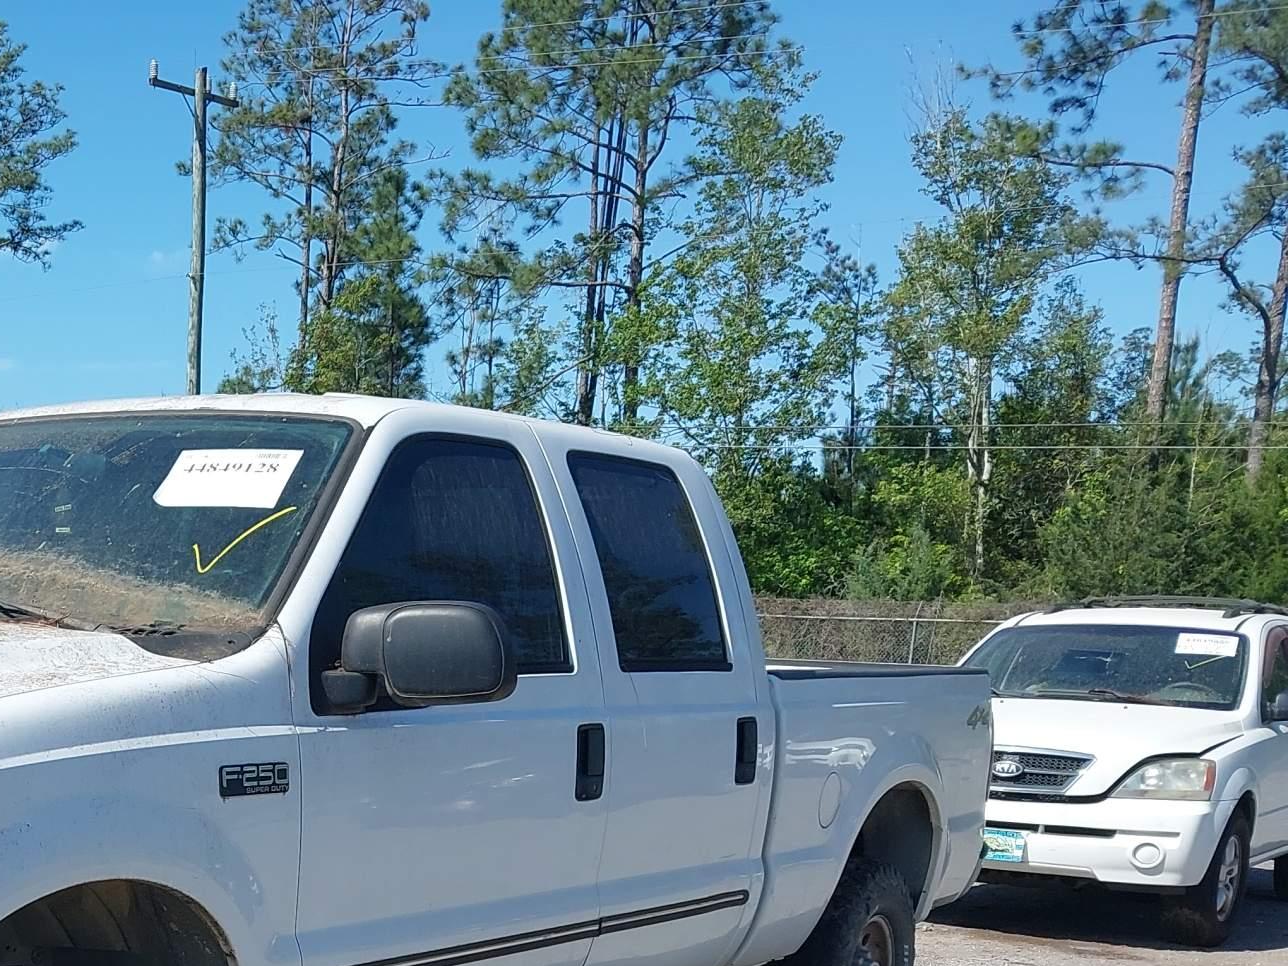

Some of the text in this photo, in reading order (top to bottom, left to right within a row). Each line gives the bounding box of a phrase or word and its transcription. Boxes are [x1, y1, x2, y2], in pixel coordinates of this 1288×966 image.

[184, 463, 280, 473] 44849128
[995, 763, 1017, 773] KIA
[246, 786, 270, 794] SUPER
